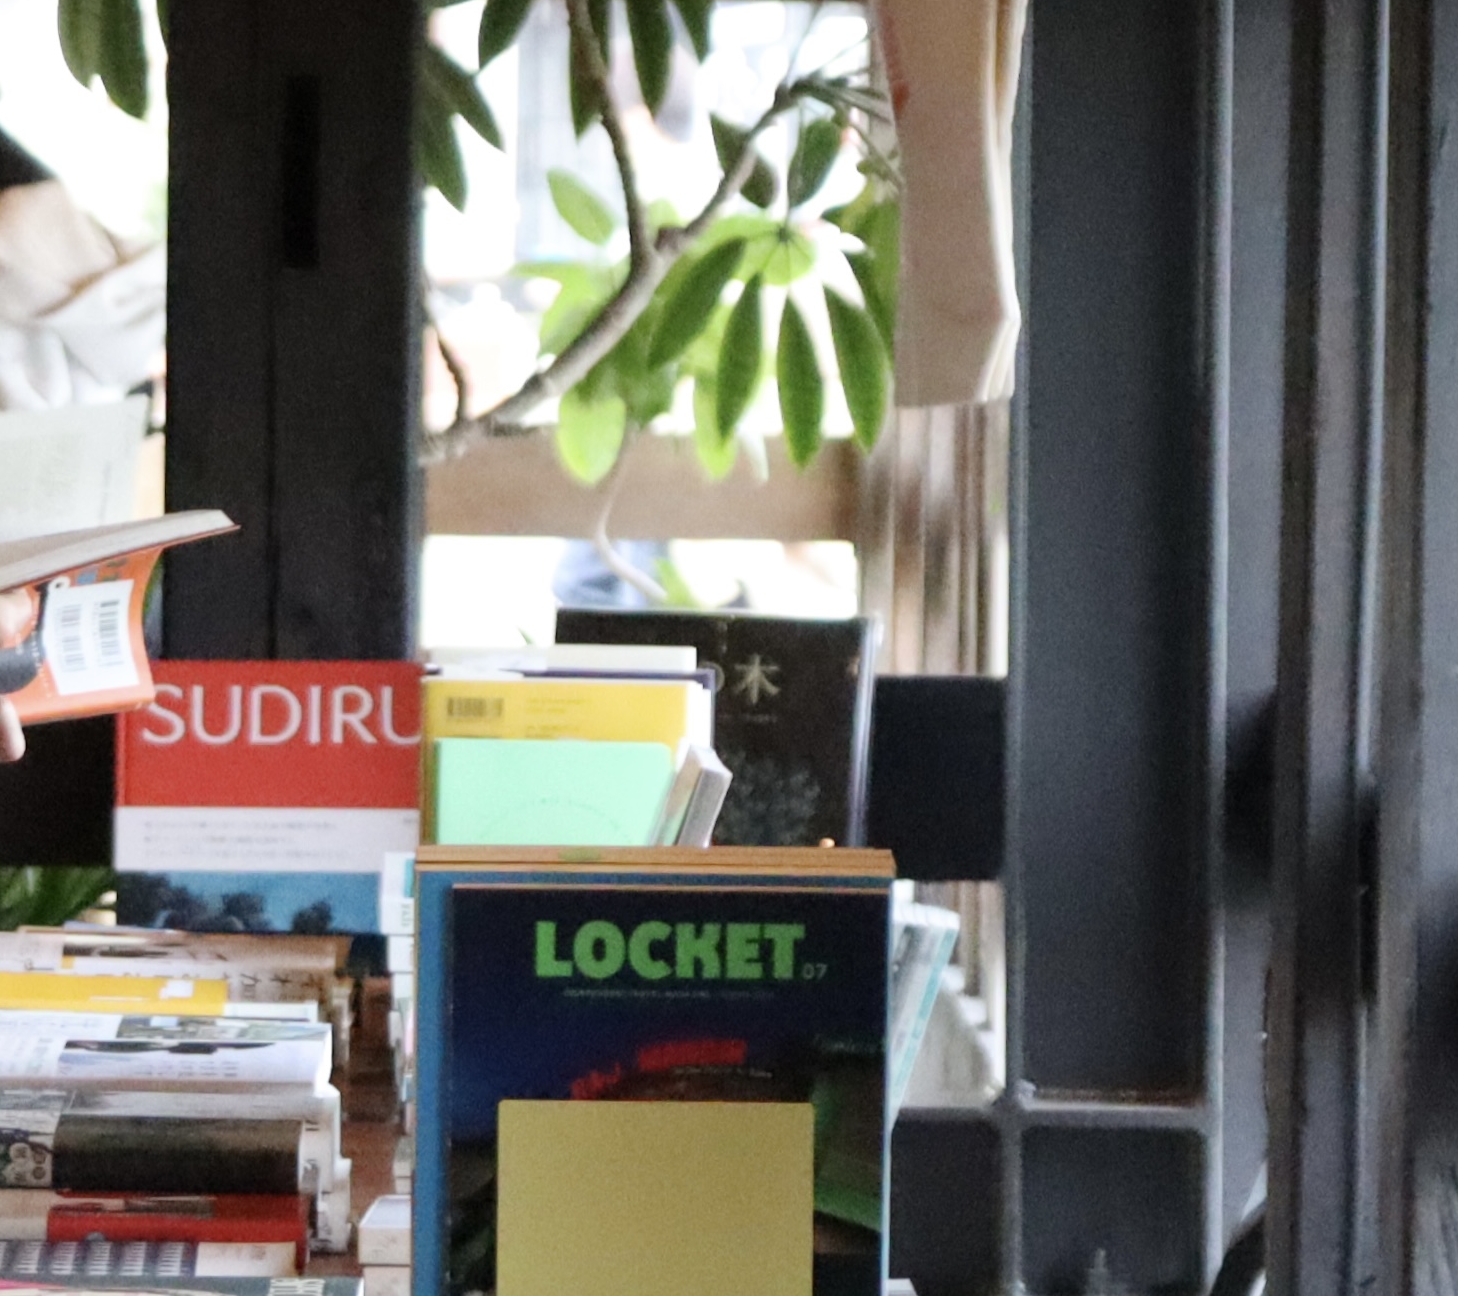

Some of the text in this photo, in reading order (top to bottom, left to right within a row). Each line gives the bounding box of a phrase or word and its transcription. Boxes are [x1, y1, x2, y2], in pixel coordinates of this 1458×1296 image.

[142, 683, 422, 747] SUDIRU
[534, 919, 827, 980] LOCKET 07
